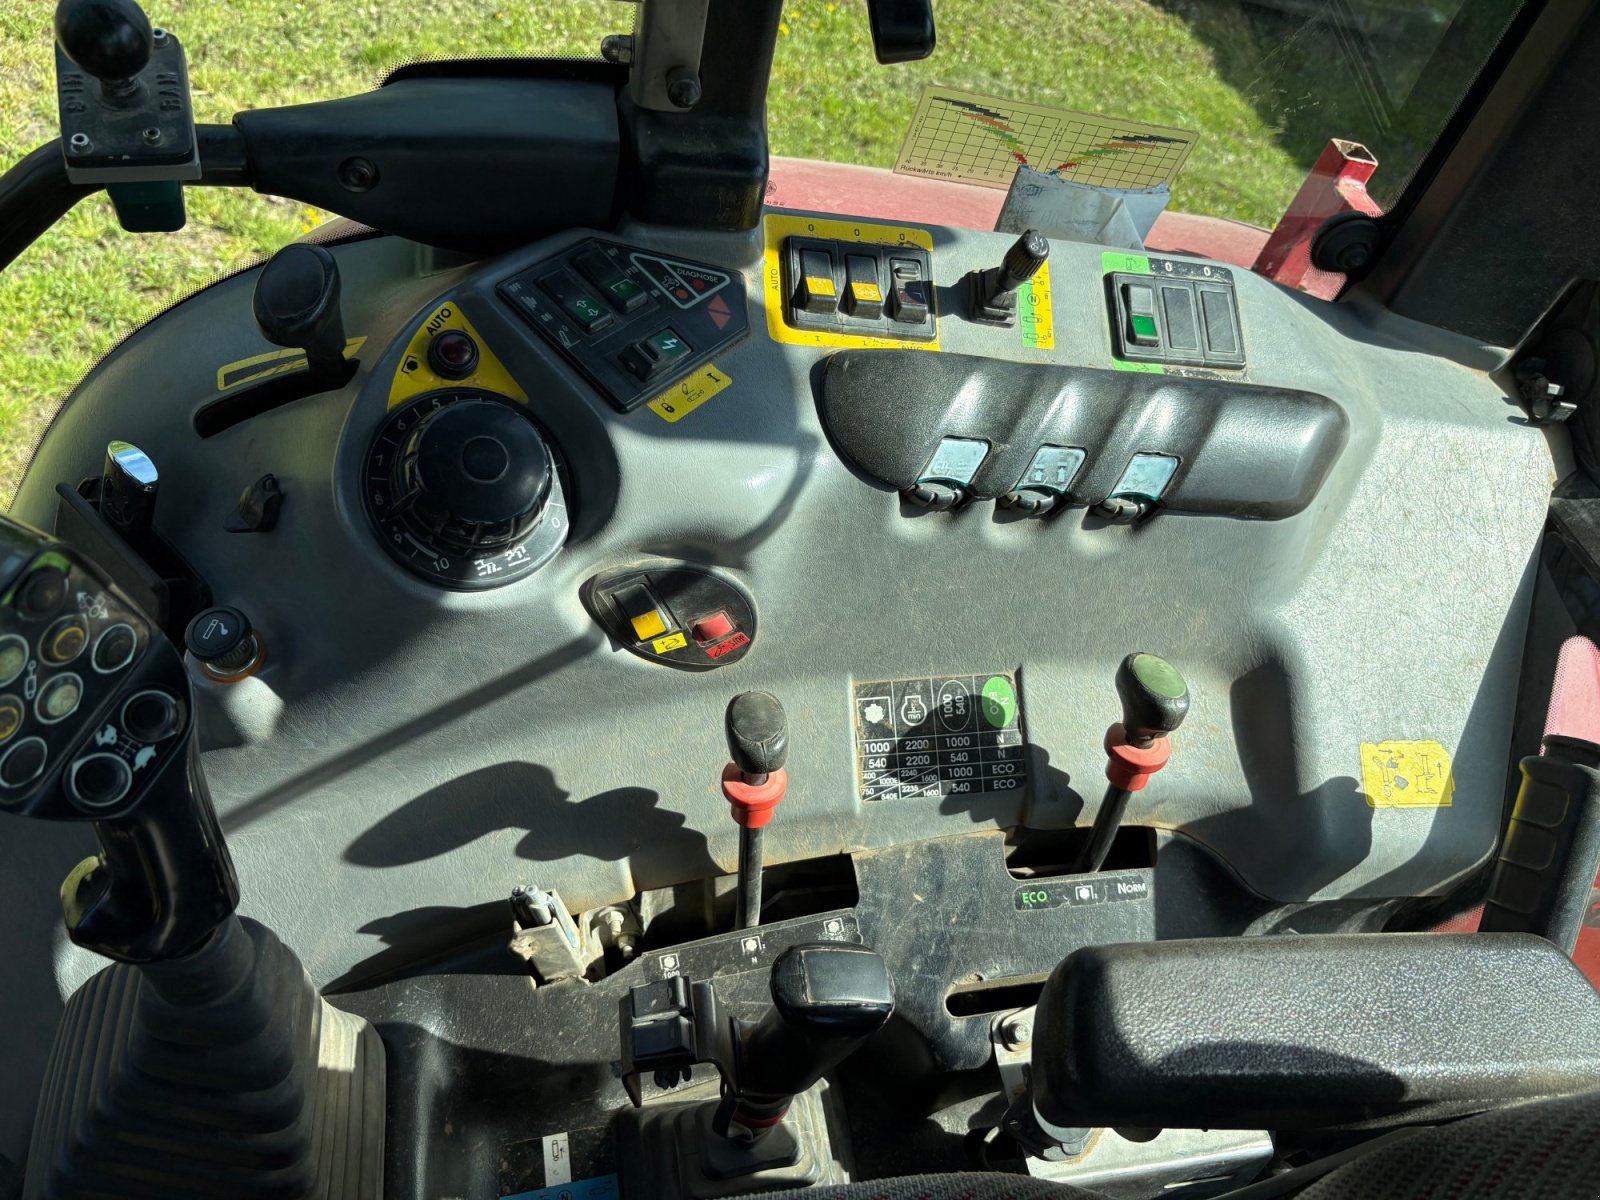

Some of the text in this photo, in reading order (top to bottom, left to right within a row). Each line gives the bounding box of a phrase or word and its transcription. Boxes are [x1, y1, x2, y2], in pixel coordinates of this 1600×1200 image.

[1165, 261, 1172, 272] 0
[1203, 266, 1211, 277] 0
[676, 267, 718, 283] DIAGNOSE
[771, 268, 779, 291] AUTO
[425, 308, 452, 336] AUTO
[432, 399, 441, 409] 5
[397, 419, 406, 431] 6
[375, 454, 383, 467] 7
[374, 494, 384, 506] 8
[433, 557, 450, 571] 10
[943, 694, 953, 718] 1000
[955, 695, 965, 715] 540
[989, 692, 998, 715] ECO
[864, 734, 1004, 753] 1000 2200 1000 N
[868, 750, 1005, 769] 540 2200 540 N
[900, 769, 918, 777] 2240
[948, 764, 1015, 778] 1000 ECO
[921, 775, 938, 783] 1600
[901, 785, 919, 793] 2235
[923, 789, 939, 797] 1600
[952, 780, 1016, 793] 540 ECO
[1022, 891, 1048, 903] ECO
[664, 970, 681, 979] 1000
